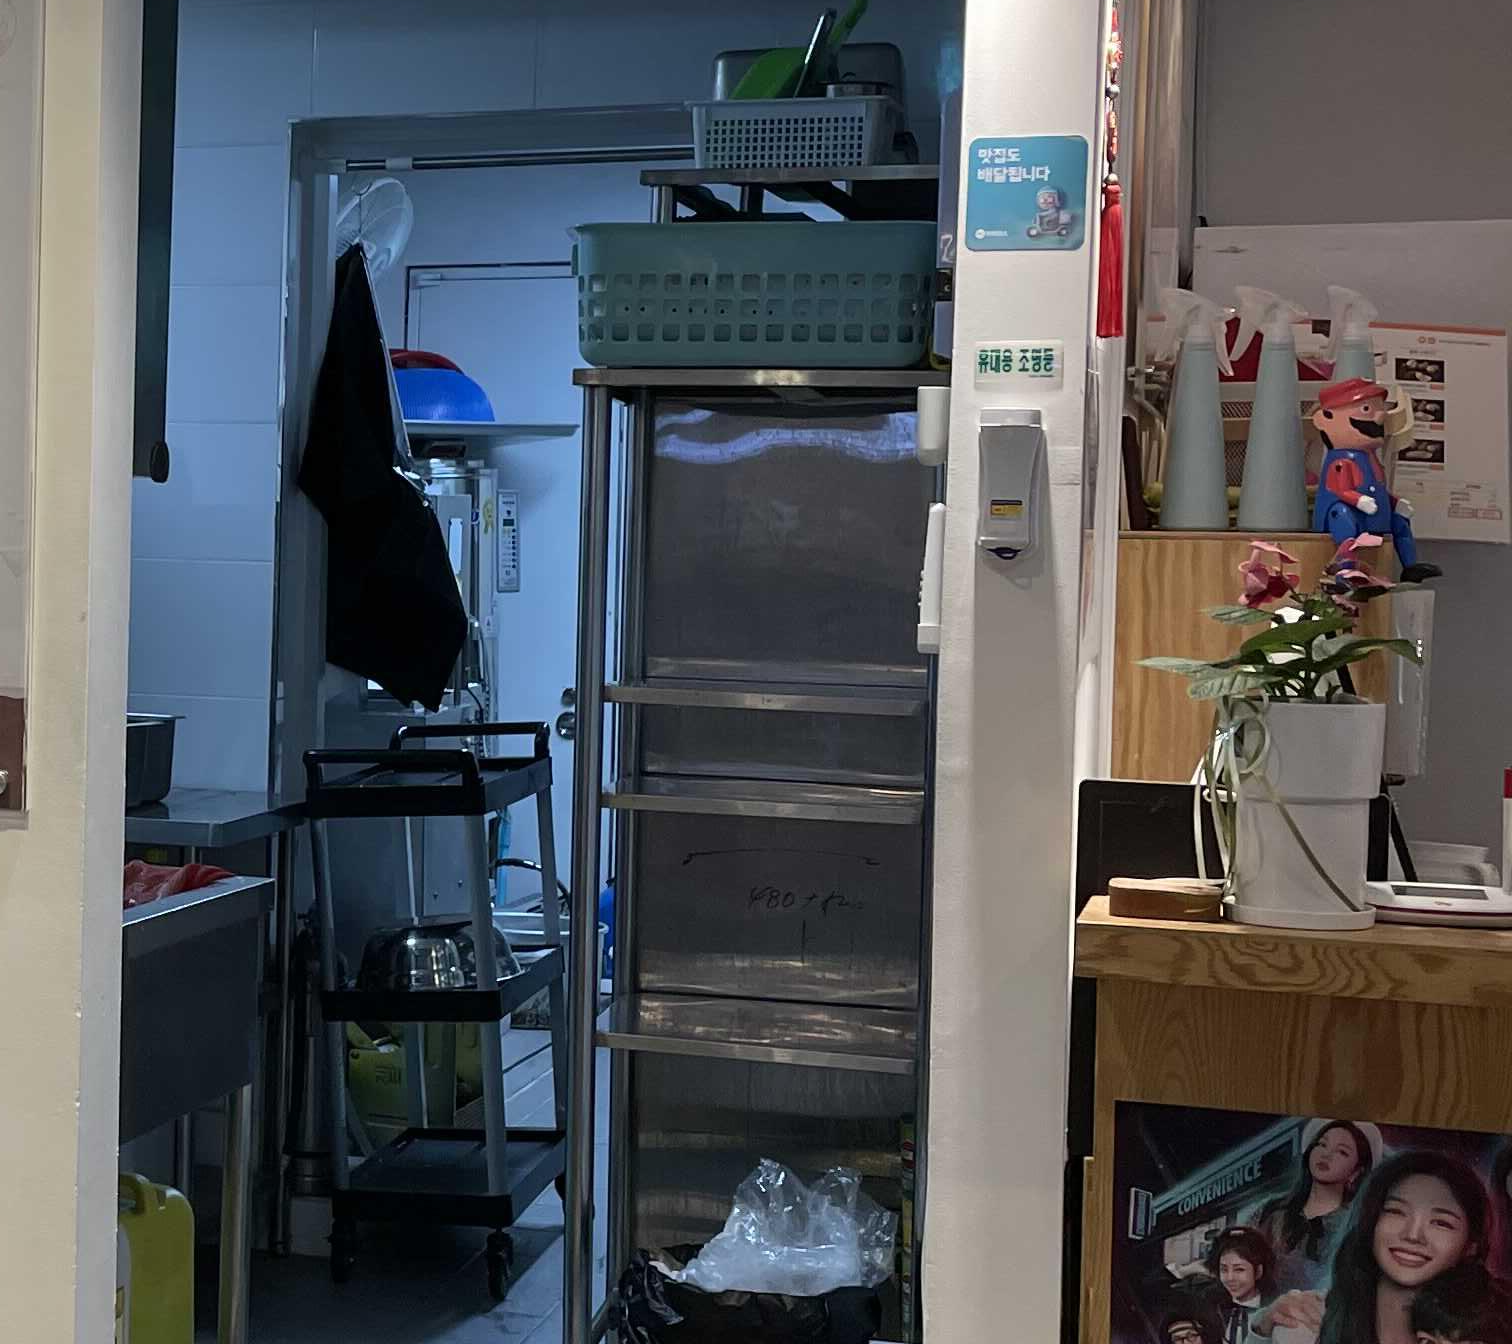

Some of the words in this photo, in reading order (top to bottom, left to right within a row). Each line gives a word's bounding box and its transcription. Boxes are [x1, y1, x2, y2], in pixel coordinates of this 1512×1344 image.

[977, 147, 1022, 164] 맛집도
[977, 165, 1051, 184] 배달됩니다
[977, 348, 1013, 374] 휴대용
[1177, 1156, 1264, 1217] CONVENIENCE
